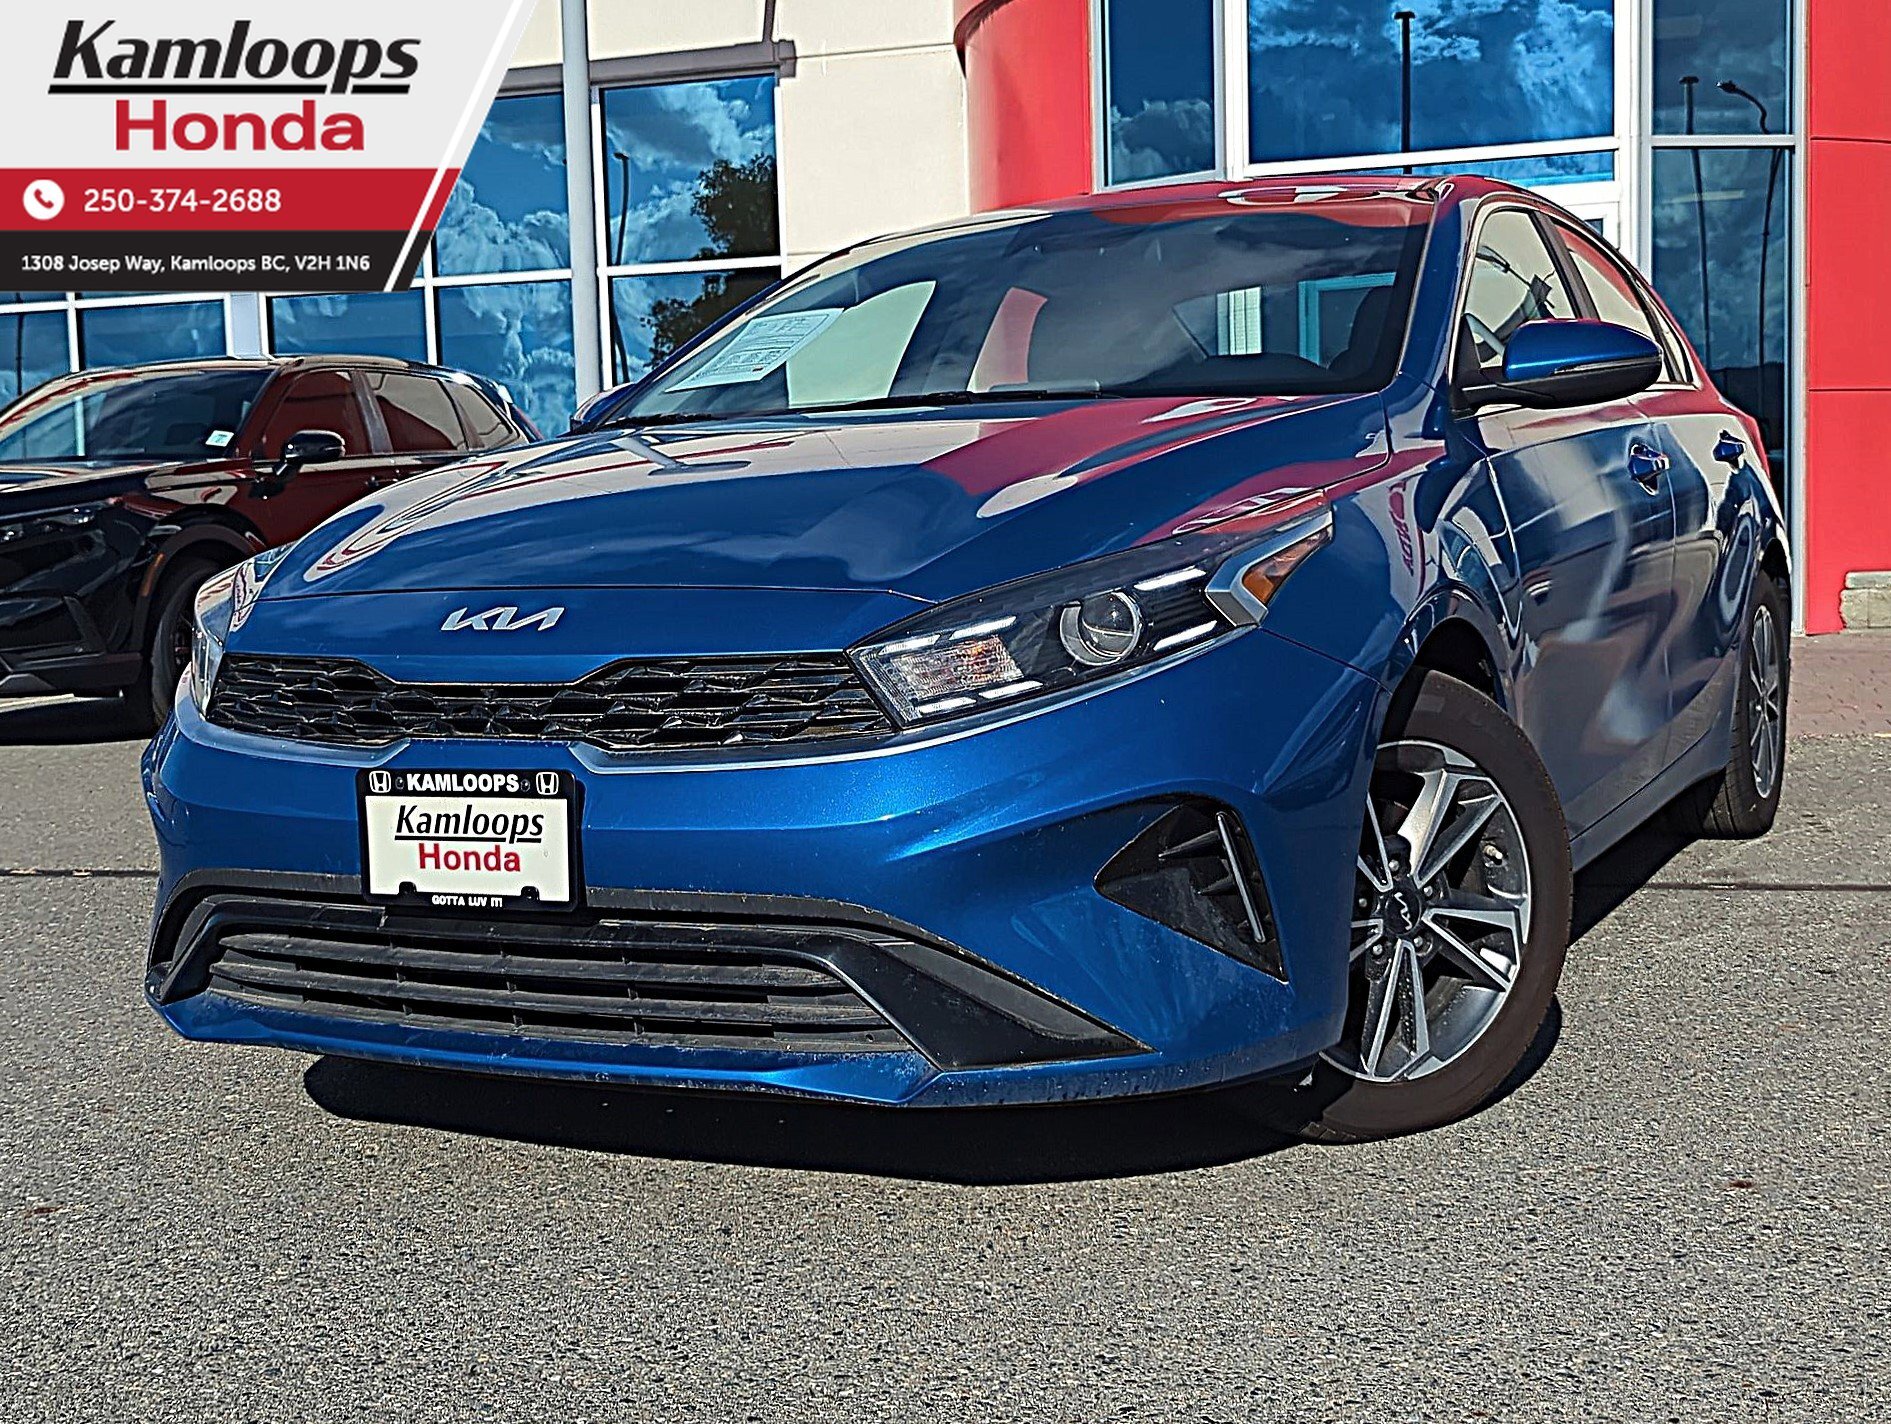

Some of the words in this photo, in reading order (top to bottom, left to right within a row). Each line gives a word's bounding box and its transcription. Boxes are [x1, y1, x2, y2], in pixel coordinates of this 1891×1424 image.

[440, 606, 565, 631] KIA
[406, 773, 520, 792] KAMLOOPS
[395, 804, 545, 844] Kamloops
[418, 842, 521, 873] Honda
[431, 894, 466, 906] GOTTA
[468, 896, 488, 907] LUV
